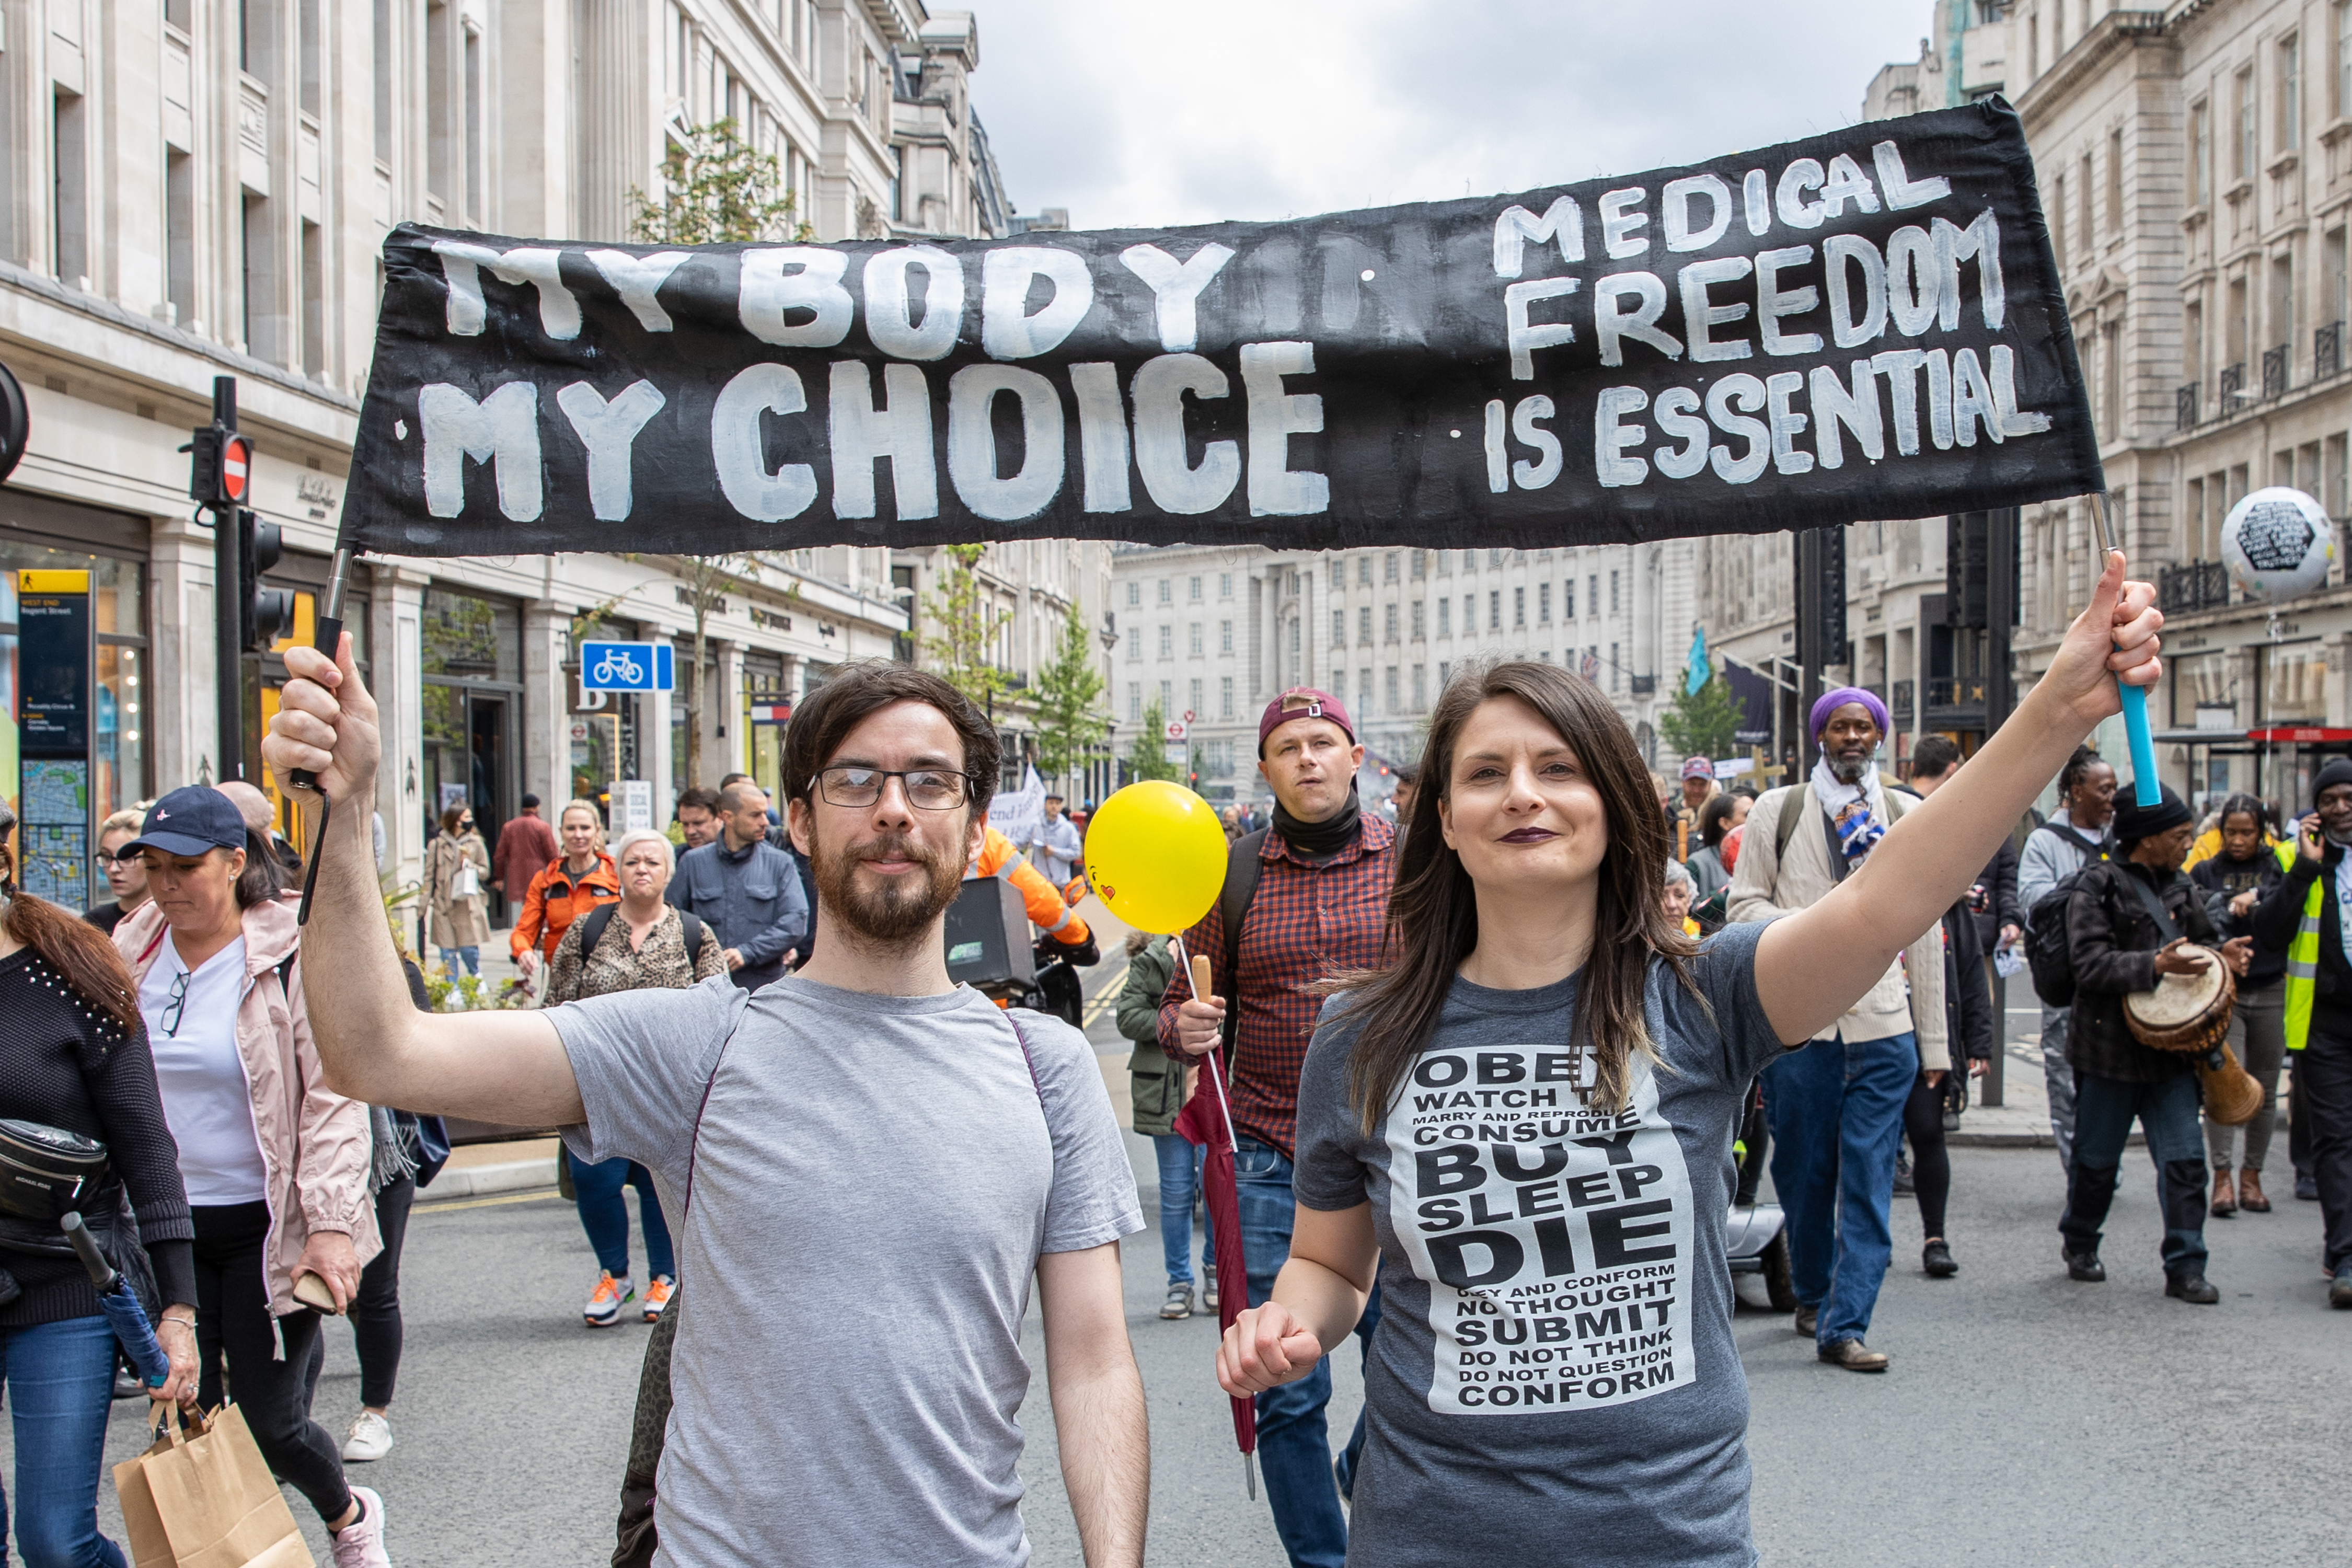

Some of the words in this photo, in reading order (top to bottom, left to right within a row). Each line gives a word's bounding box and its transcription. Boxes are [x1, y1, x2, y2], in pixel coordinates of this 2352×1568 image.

[1493, 140, 1952, 278] MEDICAL
[431, 240, 694, 340] MY
[739, 242, 1236, 361] BODY
[1504, 207, 2005, 381] FREEDOM
[418, 379, 666, 522] MY
[712, 341, 1330, 522] CHOICE
[1484, 394, 1563, 493] IS
[1595, 344, 2053, 487] ESSENTIAL
[21, 607, 47, 616] Regent
[1412, 1112, 1477, 1125] MARRY
[1483, 1113, 1521, 1121] AND
[1413, 1088, 1557, 1113] WATCH
[1414, 1104, 1641, 1146] CONSUME
[1415, 1127, 1648, 1199] BUY
[1417, 1164, 1663, 1232] SLEEP
[1425, 1198, 1677, 1289] DIE
[1457, 1300, 1498, 1317] NO
[1505, 1277, 1676, 1315] THOUGHT
[1510, 1283, 1557, 1298] AND
[1564, 1264, 1675, 1289] CONFORM
[1454, 1297, 1676, 1347] SUBMIT
[1459, 1351, 1496, 1366] DO
[1509, 1346, 1573, 1365] NOT
[1583, 1327, 1673, 1358] THINK
[1459, 1370, 1490, 1382] DO
[1497, 1368, 1547, 1382] NOT
[1558, 1346, 1673, 1378] QUESTION
[1458, 1361, 1675, 1407] CONFORM
